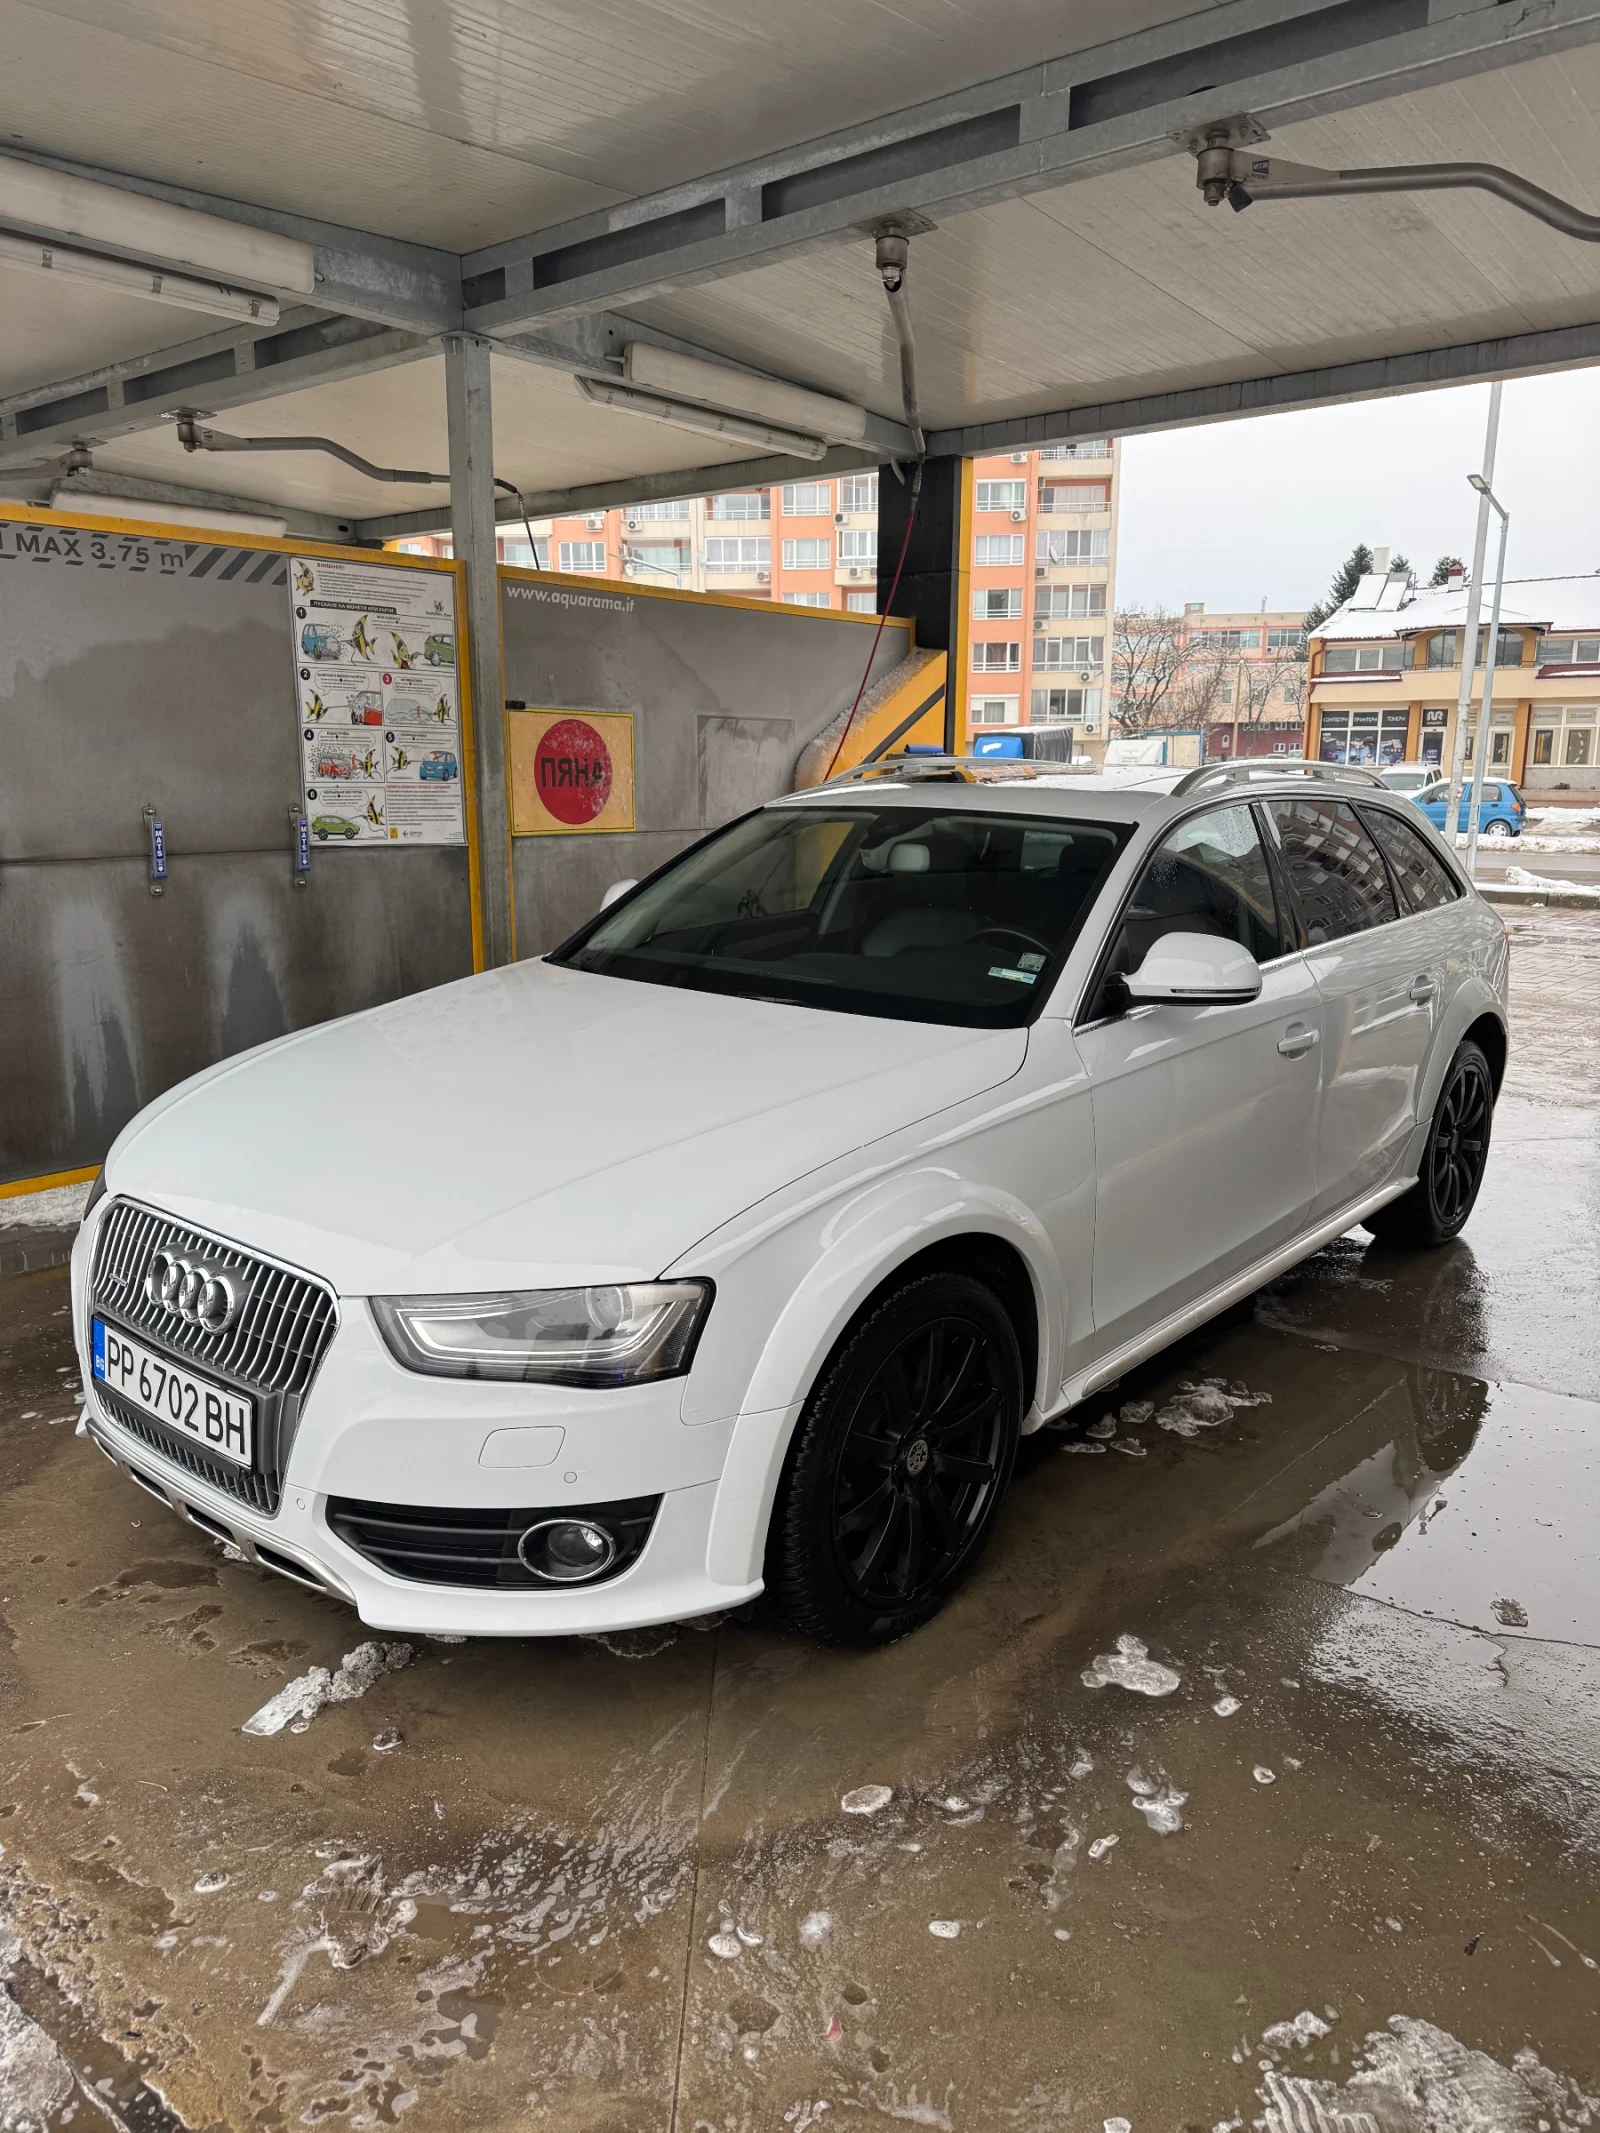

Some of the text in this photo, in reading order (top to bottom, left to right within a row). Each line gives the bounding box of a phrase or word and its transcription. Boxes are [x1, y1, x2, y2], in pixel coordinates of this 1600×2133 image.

[16, 533, 82, 557] MAX
[91, 541, 150, 564] 3.75
[160, 552, 184, 568] m
[506, 586, 635, 612] www.aquarama.it
[540, 757, 605, 788] ПЯНА
[155, 830, 163, 857] MATS
[95, 1354, 105, 1371] BG
[107, 1334, 246, 1455] PP 6702 BH
